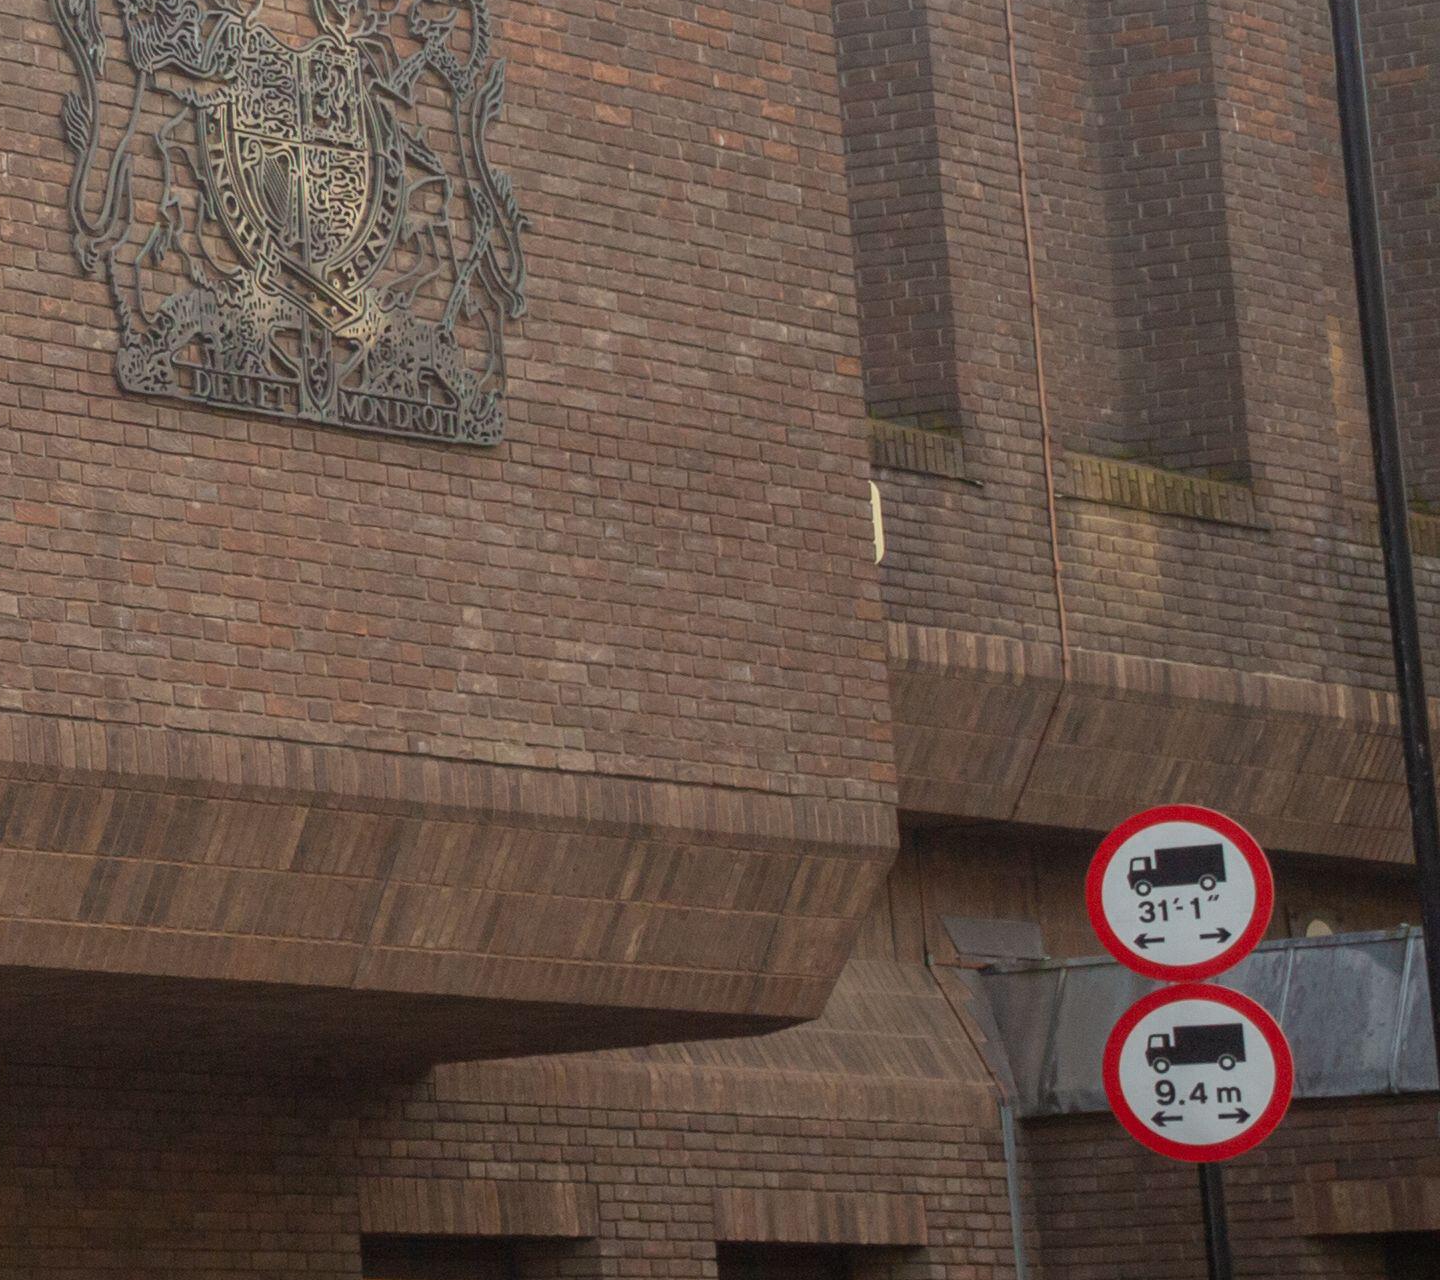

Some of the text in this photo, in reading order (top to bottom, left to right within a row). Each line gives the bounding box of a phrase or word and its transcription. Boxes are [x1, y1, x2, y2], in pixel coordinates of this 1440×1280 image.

[194, 370, 457, 437] DIEU ET MON DROIT
[1155, 1079, 1242, 1106] 9.4 m
